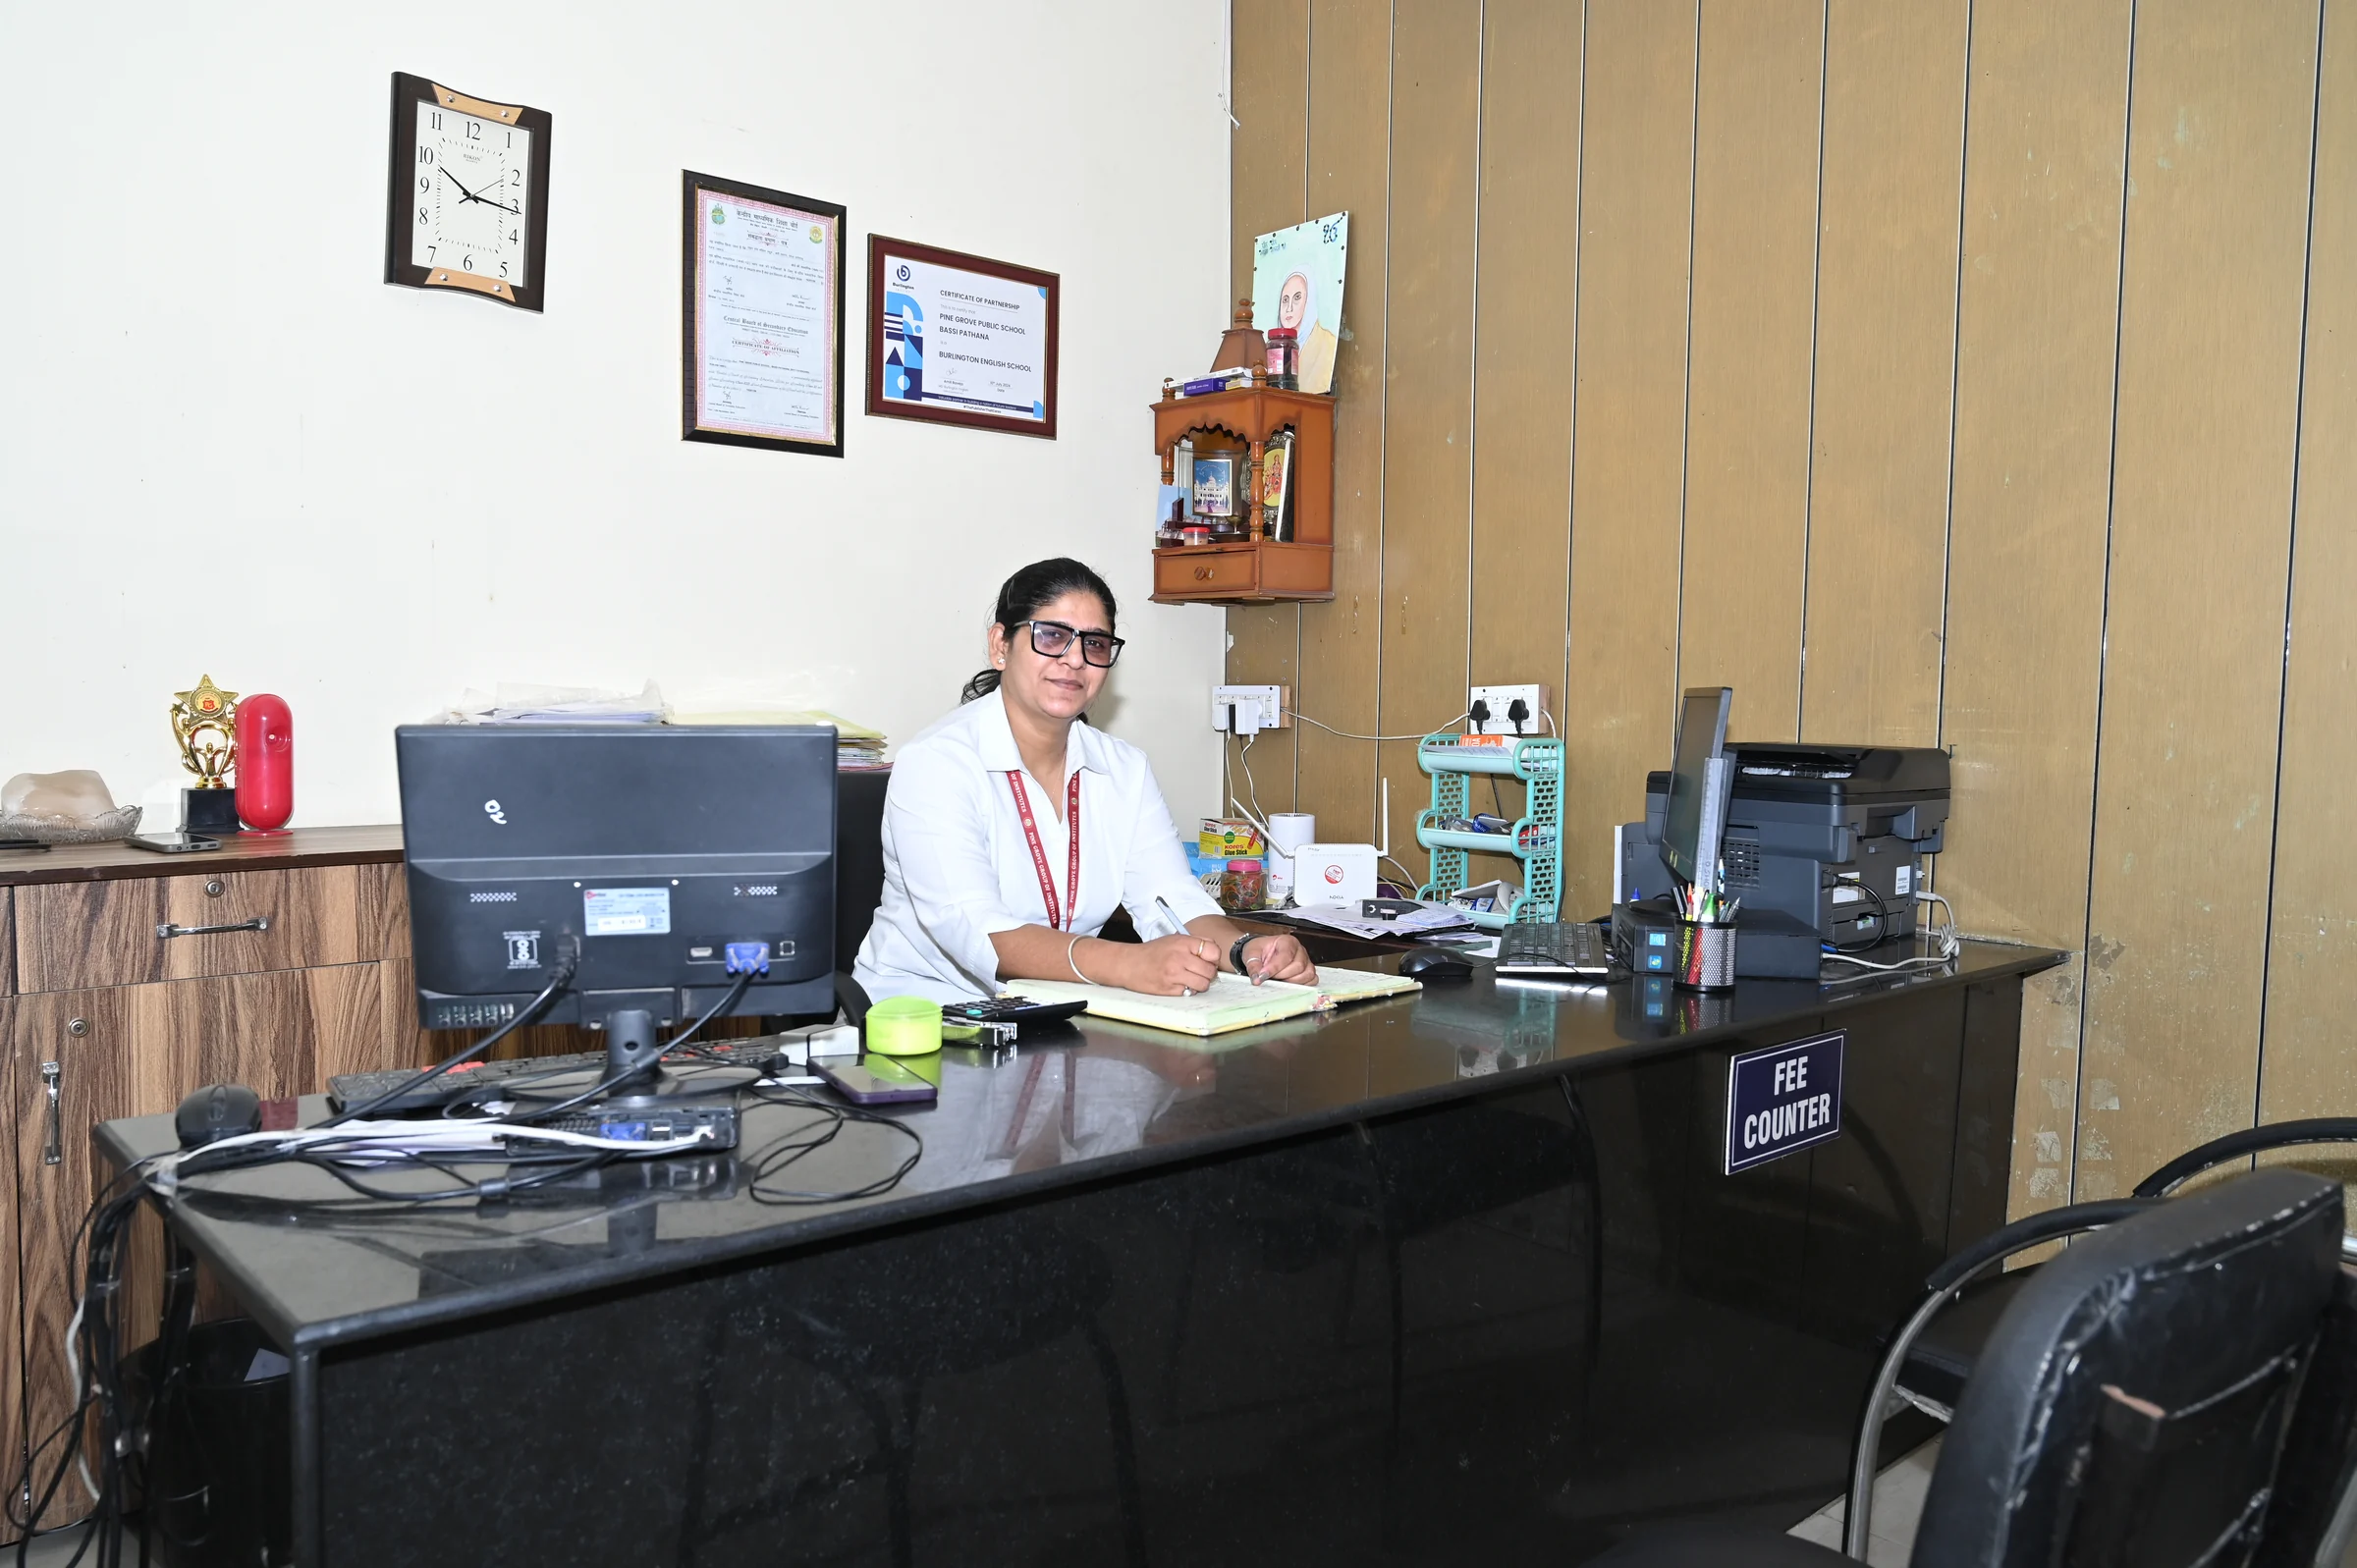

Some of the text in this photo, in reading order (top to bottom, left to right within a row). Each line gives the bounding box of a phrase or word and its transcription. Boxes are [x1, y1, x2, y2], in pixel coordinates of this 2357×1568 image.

[431, 112, 442, 130] 11
[466, 121, 481, 140] 12
[506, 132, 511, 149] 1
[419, 146, 433, 165] 10
[420, 177, 430, 193] 9
[511, 169, 520, 187] 2
[419, 207, 428, 225] 8
[511, 199, 519, 216] 3
[509, 228, 518, 245] 4
[427, 245, 437, 262] 7
[463, 254, 473, 271] 6
[499, 262, 507, 278] 5
[940, 290, 974, 302] CERTIFICATE
[984, 298, 1020, 310] PARTNERSHIP
[940, 313, 1025, 335] PINE GROVE PUBLIC SCHOOL
[940, 326, 989, 341] BASSI PATHANA
[732, 340, 762, 348] CERTIFICATE
[771, 346, 800, 354] AFFILIATION
[939, 351, 1031, 373] BURLINGTON ENGLISH SCHOOL
[1013, 781, 1027, 812] INSTITUTES
[1033, 845, 1042, 864] GROVE
[1039, 865, 1048, 883] GROUP
[1047, 892, 1057, 924] INSTITUTES
[1774, 1056, 1808, 1096] FEE
[1744, 1093, 1831, 1149] COUNTER
